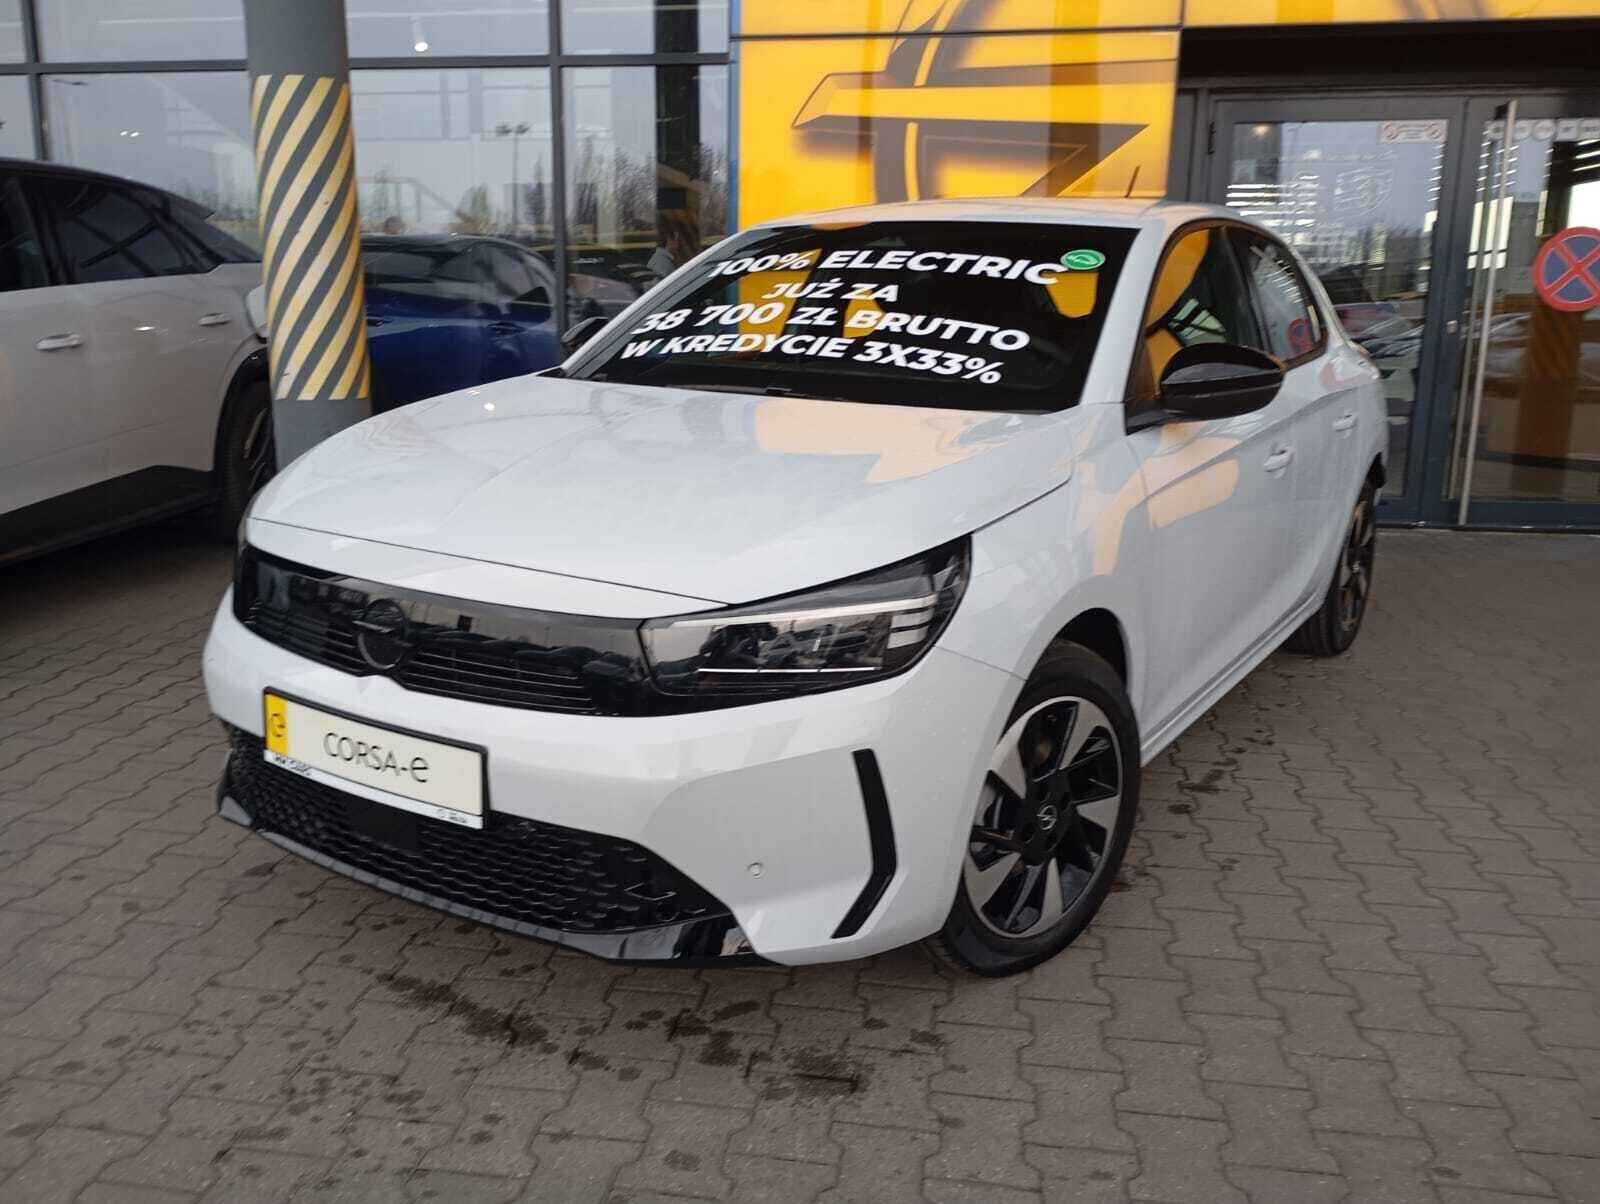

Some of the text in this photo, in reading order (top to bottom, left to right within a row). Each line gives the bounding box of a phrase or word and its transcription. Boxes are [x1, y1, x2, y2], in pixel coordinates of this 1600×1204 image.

[708, 250, 1068, 285] 100% ELECTRIC
[761, 278, 899, 302] JUŻ ZA
[631, 302, 1030, 350] 38 700 ZŁ BRUTTO
[620, 334, 1004, 384] W KREDYCIE 3X33%
[323, 732, 429, 783] CORSA-e
